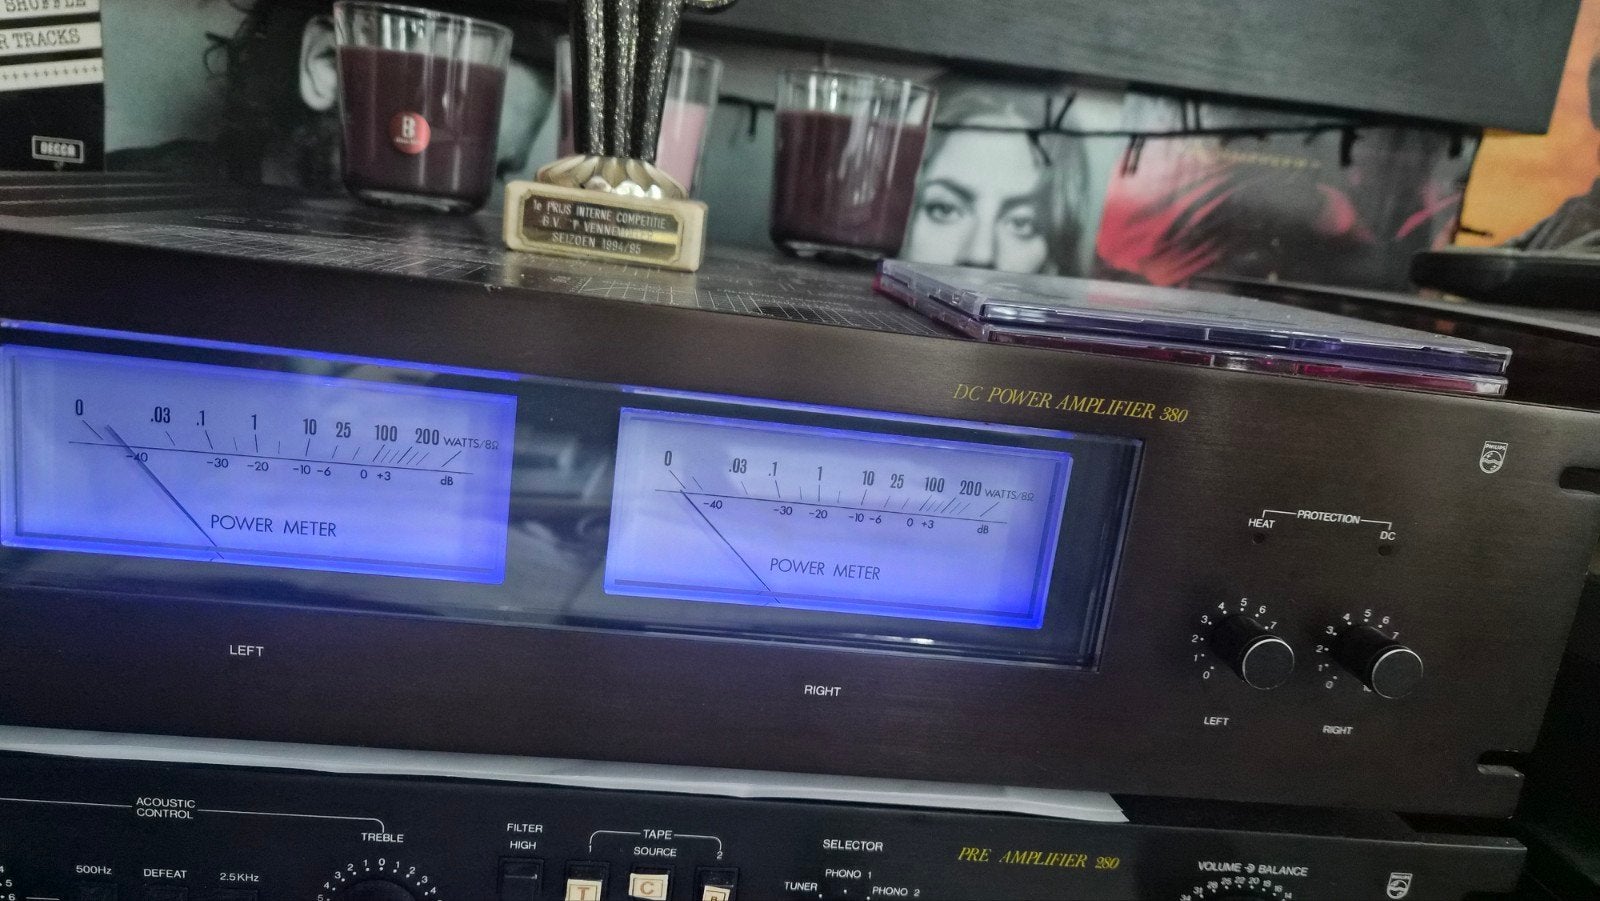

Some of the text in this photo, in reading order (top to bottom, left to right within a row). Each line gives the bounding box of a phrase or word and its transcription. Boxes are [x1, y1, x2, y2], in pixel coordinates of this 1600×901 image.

[12, 28, 80, 48] TRACKS
[402, 115, 415, 138] B
[547, 201, 572, 215] PRIJS
[576, 206, 612, 221] INTERNE
[616, 211, 666, 229] COMPETITIE
[552, 232, 596, 248] SEIZOEN
[953, 383, 1189, 423] DC POWER AMPLIFIER 380
[75, 399, 84, 416] 0
[150, 406, 171, 423] .03
[196, 410, 205, 426] .1
[251, 414, 257, 430] 1
[303, 418, 317, 435] 10
[336, 421, 351, 438] 25
[374, 424, 398, 442] 100
[415, 428, 439, 445] 200
[206, 458, 229, 468] -30
[247, 461, 269, 472] -20
[292, 465, 311, 475] -10
[316, 466, 331, 476] -6
[360, 469, 368, 479] 0
[376, 471, 391, 481] +3
[440, 476, 454, 486] dB
[664, 450, 672, 466] 0
[729, 457, 748, 474] .03
[768, 461, 778, 477] .1
[862, 470, 875, 486] 10
[890, 473, 905, 489] 25
[925, 476, 945, 493] 100
[959, 480, 982, 497] 200
[703, 500, 989, 534] -40 -30 -20 -10 -6 0 +3 dB
[1297, 509, 1361, 525] PROTECTION
[211, 514, 337, 537] POWER METER
[1248, 518, 1276, 529] HEAT
[1379, 530, 1396, 541] DC
[770, 557, 880, 580] POWER METER
[1218, 602, 1225, 610] 4
[1240, 597, 1248, 607] 5
[1259, 605, 1267, 614] 6
[1364, 608, 1372, 618] 5
[1201, 615, 1209, 624] 3
[1342, 613, 1351, 621] 4
[1382, 615, 1390, 624] 6
[1270, 621, 1278, 630] 7
[1326, 625, 1334, 635] 3
[1191, 634, 1199, 643] 2
[1392, 631, 1400, 640] 7
[229, 644, 264, 657] LEFT
[1315, 644, 1324, 653] 2
[1203, 671, 1210, 679] 0
[1325, 680, 1334, 689] 0
[804, 684, 842, 697] RIGHT
[1203, 716, 1230, 726] LEFT
[1322, 725, 1354, 735] RIGHT
[136, 797, 196, 809] ACOUSTIC
[136, 808, 194, 819] CONTROL
[506, 823, 543, 833] FILTER
[361, 832, 404, 843] TREBLE
[643, 829, 673, 840] TAPE
[509, 840, 537, 850] HIGH
[822, 839, 884, 852] SELECTOR
[633, 846, 677, 857] SOURCE
[716, 851, 723, 860] 2
[958, 847, 1120, 869] PRE AMPLIFIER 280
[76, 864, 113, 875] 500Hz
[143, 868, 188, 879] DEFEAT
[825, 868, 862, 879] PHONO
[1198, 861, 1309, 877] VOLUME BALANCE
[219, 872, 260, 883] 2.5KHz
[335, 871, 341, 879] 3
[347, 863, 354, 872] 2
[378, 858, 386, 866] 0
[409, 866, 416, 875] 2
[421, 875, 428, 884] 3
[430, 886, 437, 894] 4
[1248, 876, 1260, 885] 20
[5, 879, 13, 887] 5
[639, 881, 654, 896] C
[784, 881, 818, 892] TUNER
[8, 893, 16, 901] 6
[577, 887, 591, 901] T
[872, 886, 921, 897] PHONO 2
